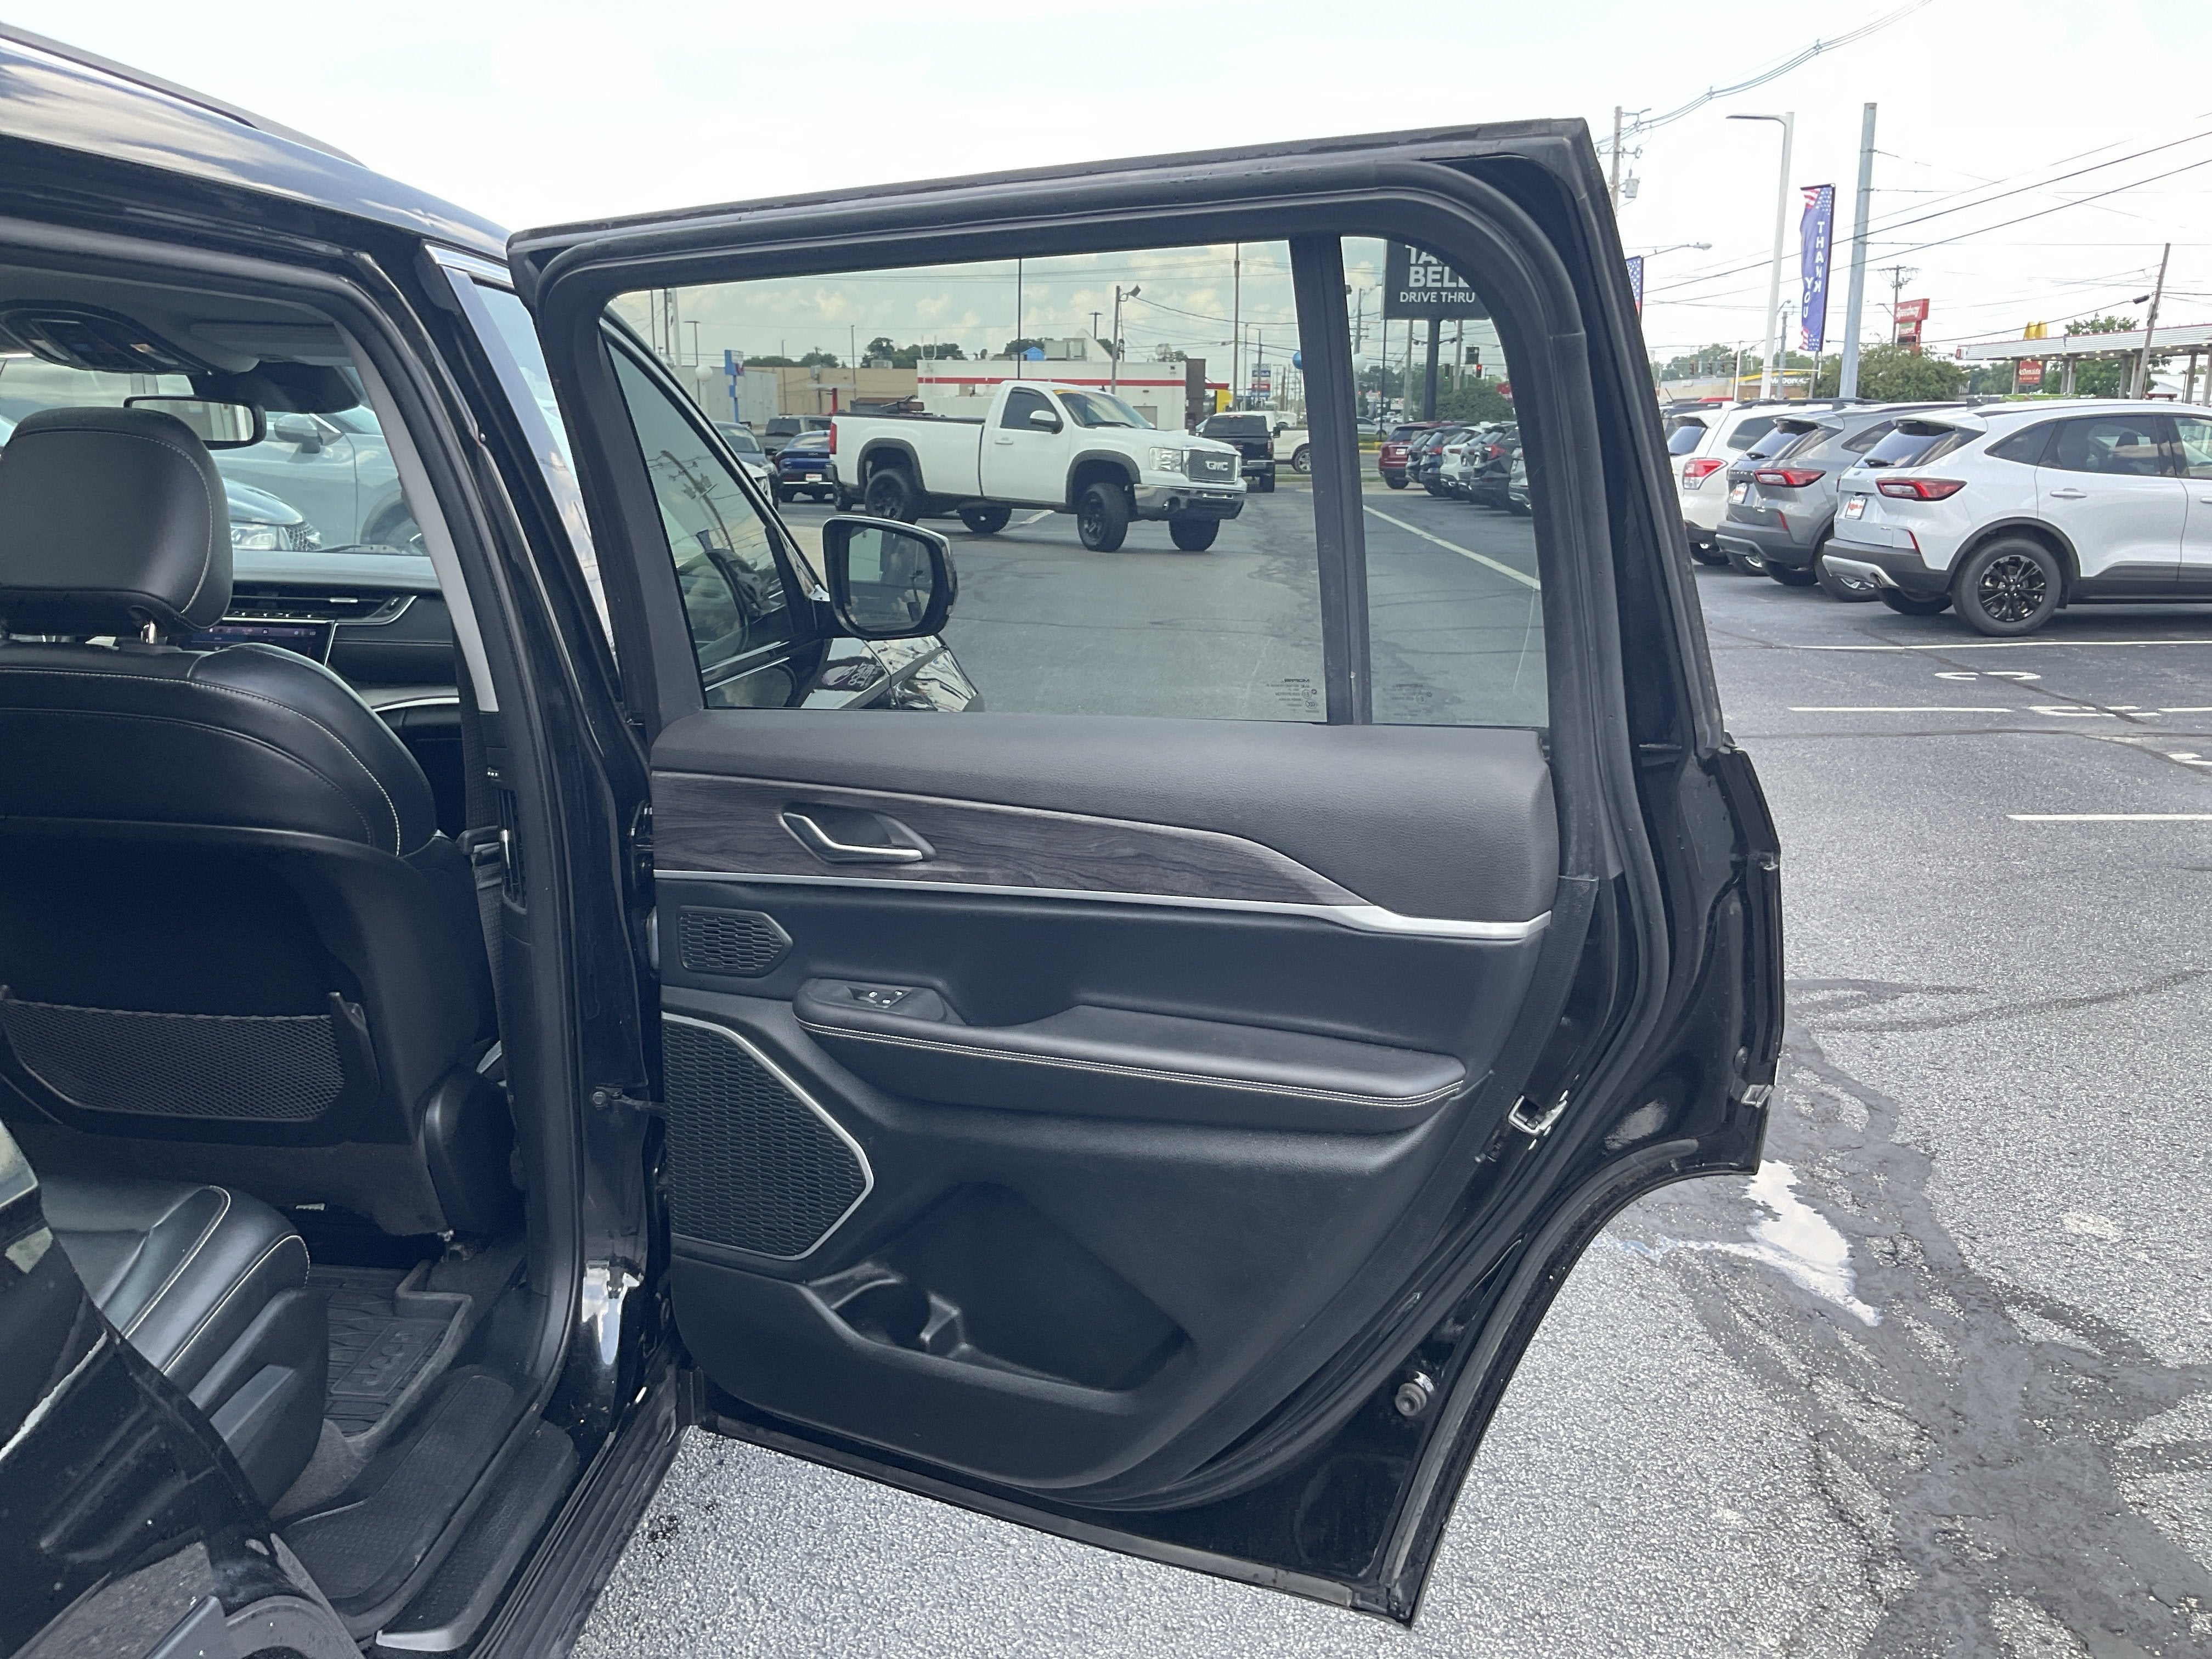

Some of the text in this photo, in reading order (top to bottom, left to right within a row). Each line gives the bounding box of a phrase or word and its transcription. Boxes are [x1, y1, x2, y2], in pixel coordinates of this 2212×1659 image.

[1404, 245, 1444, 264] TA
[1400, 291, 1475, 303] DRIVE THRU
[1205, 461, 1228, 471] GMC
